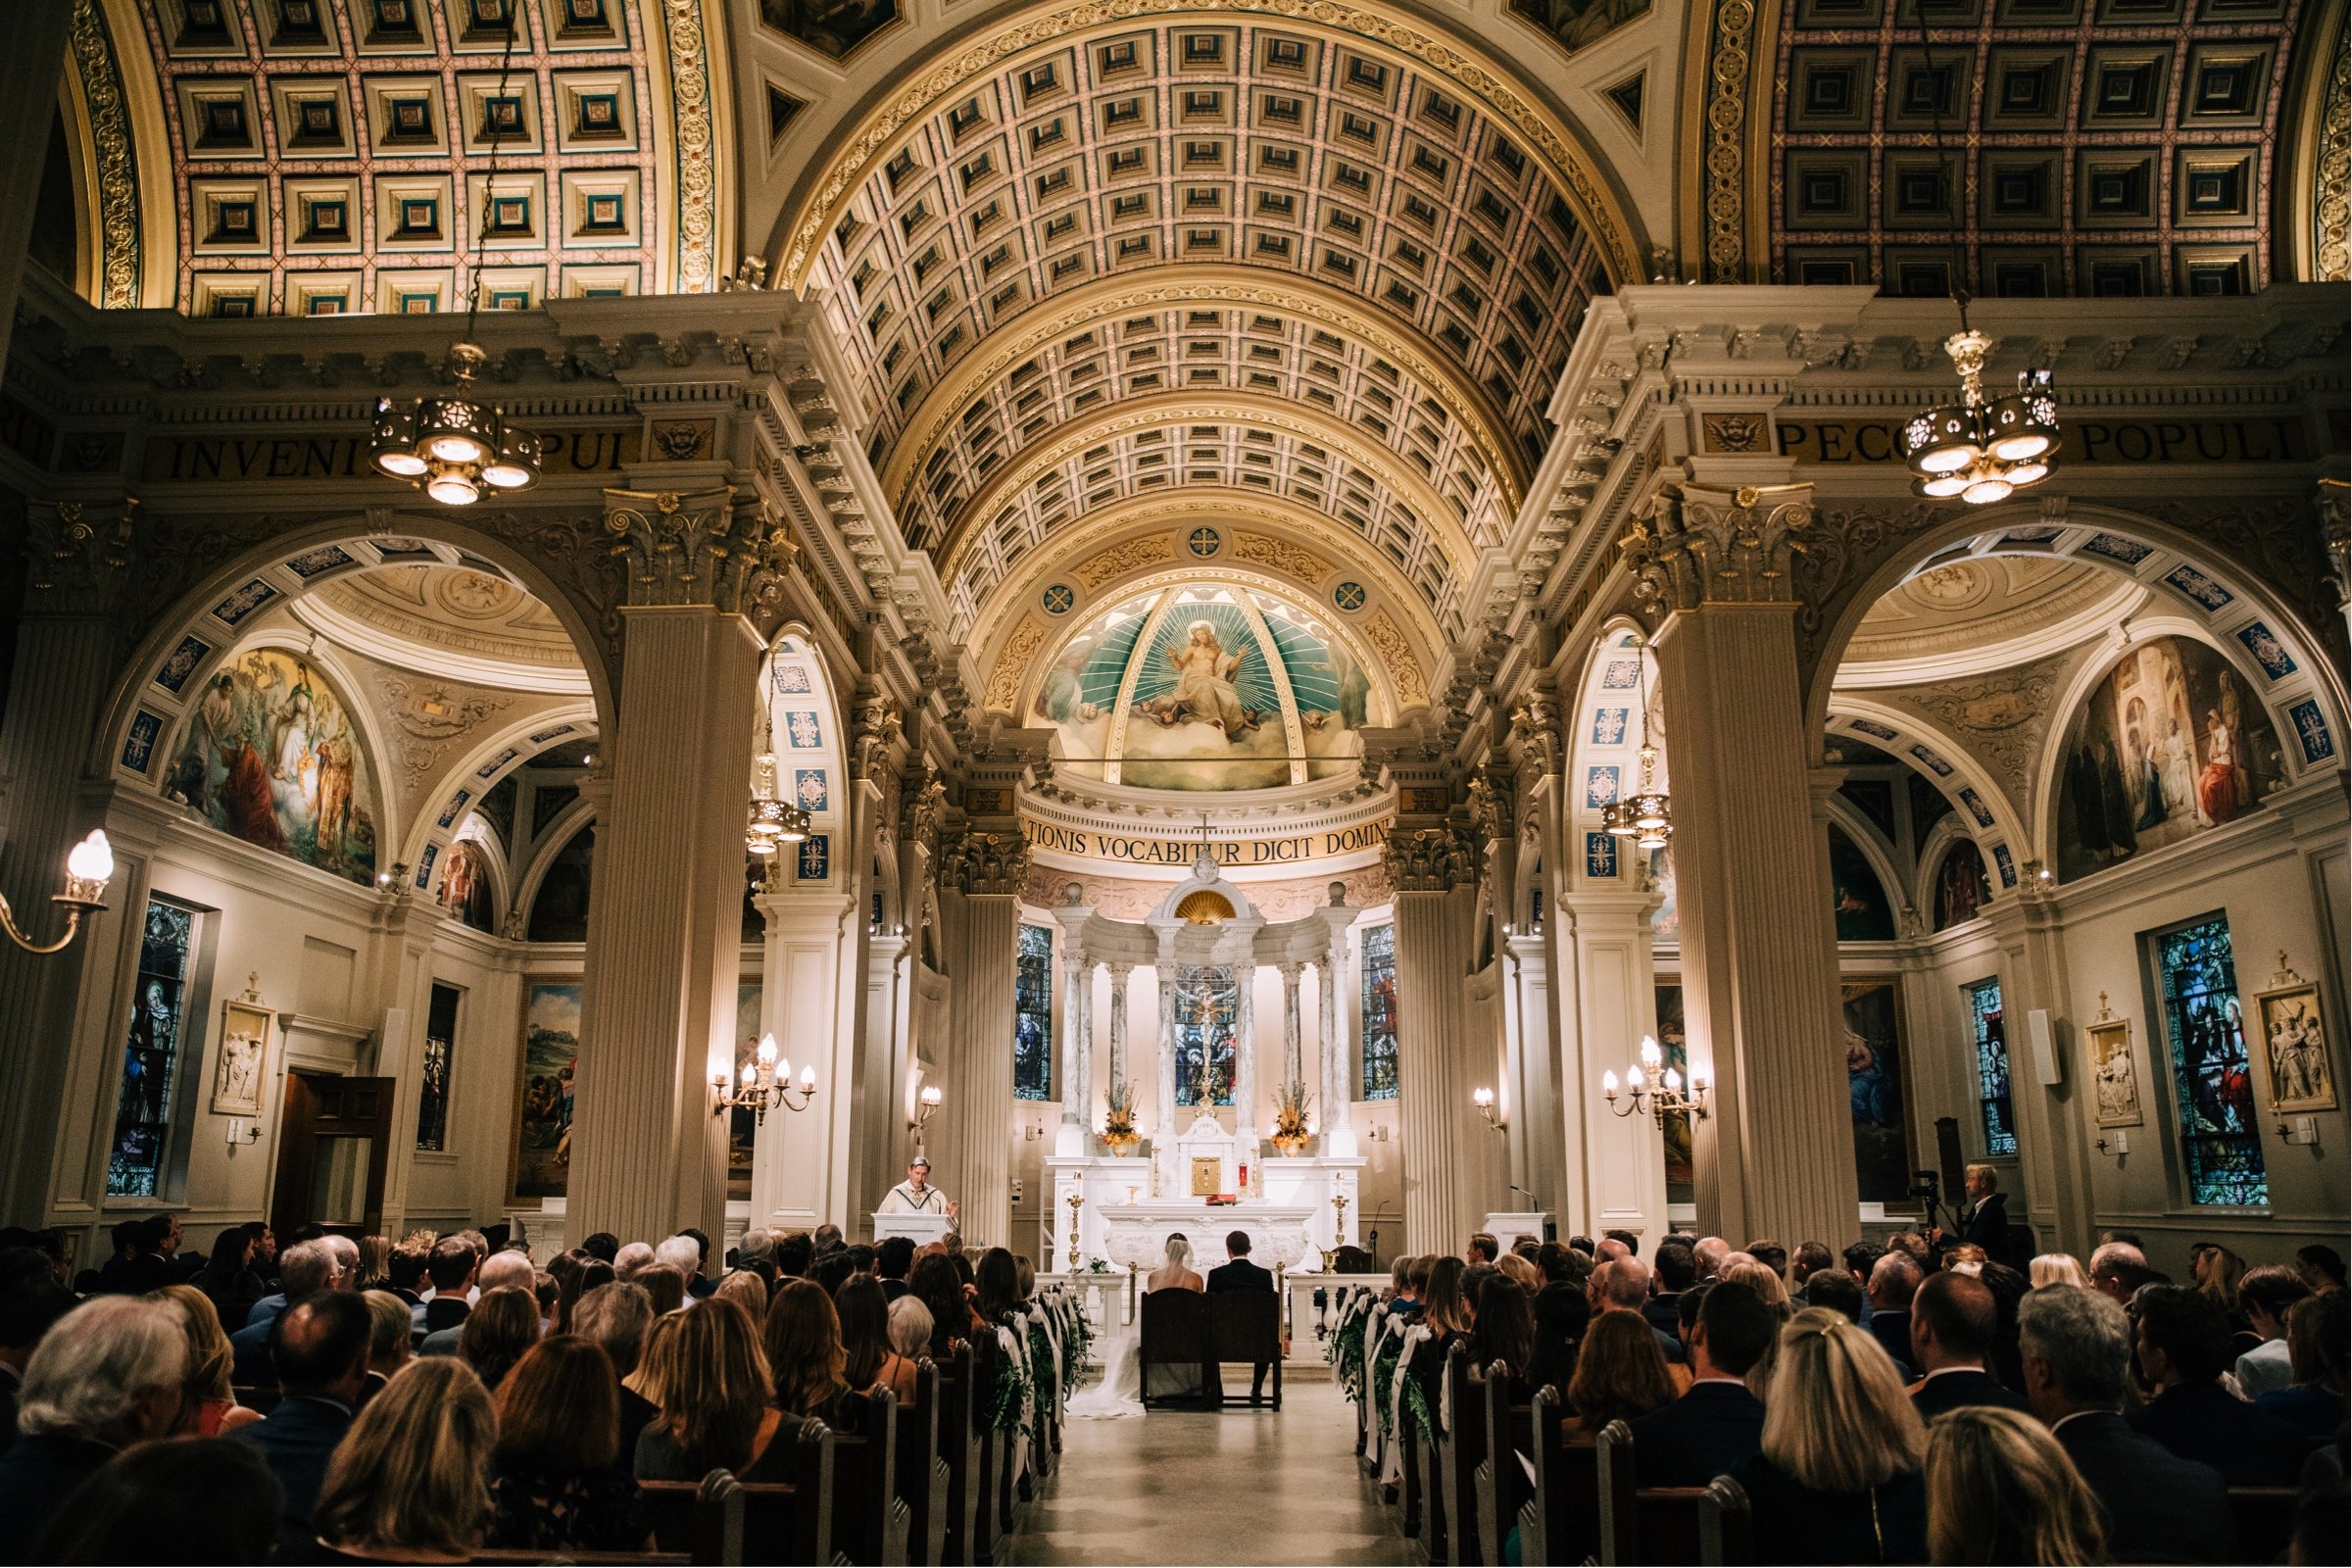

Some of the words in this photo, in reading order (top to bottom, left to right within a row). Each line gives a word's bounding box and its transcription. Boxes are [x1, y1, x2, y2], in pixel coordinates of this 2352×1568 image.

[170, 438, 378, 479] INVENI
[2078, 421, 2294, 462] POPULI
[1024, 819, 1087, 854] TIONIS
[1097, 835, 1240, 863] VOCABITUR
[1253, 836, 1314, 862] DICIT
